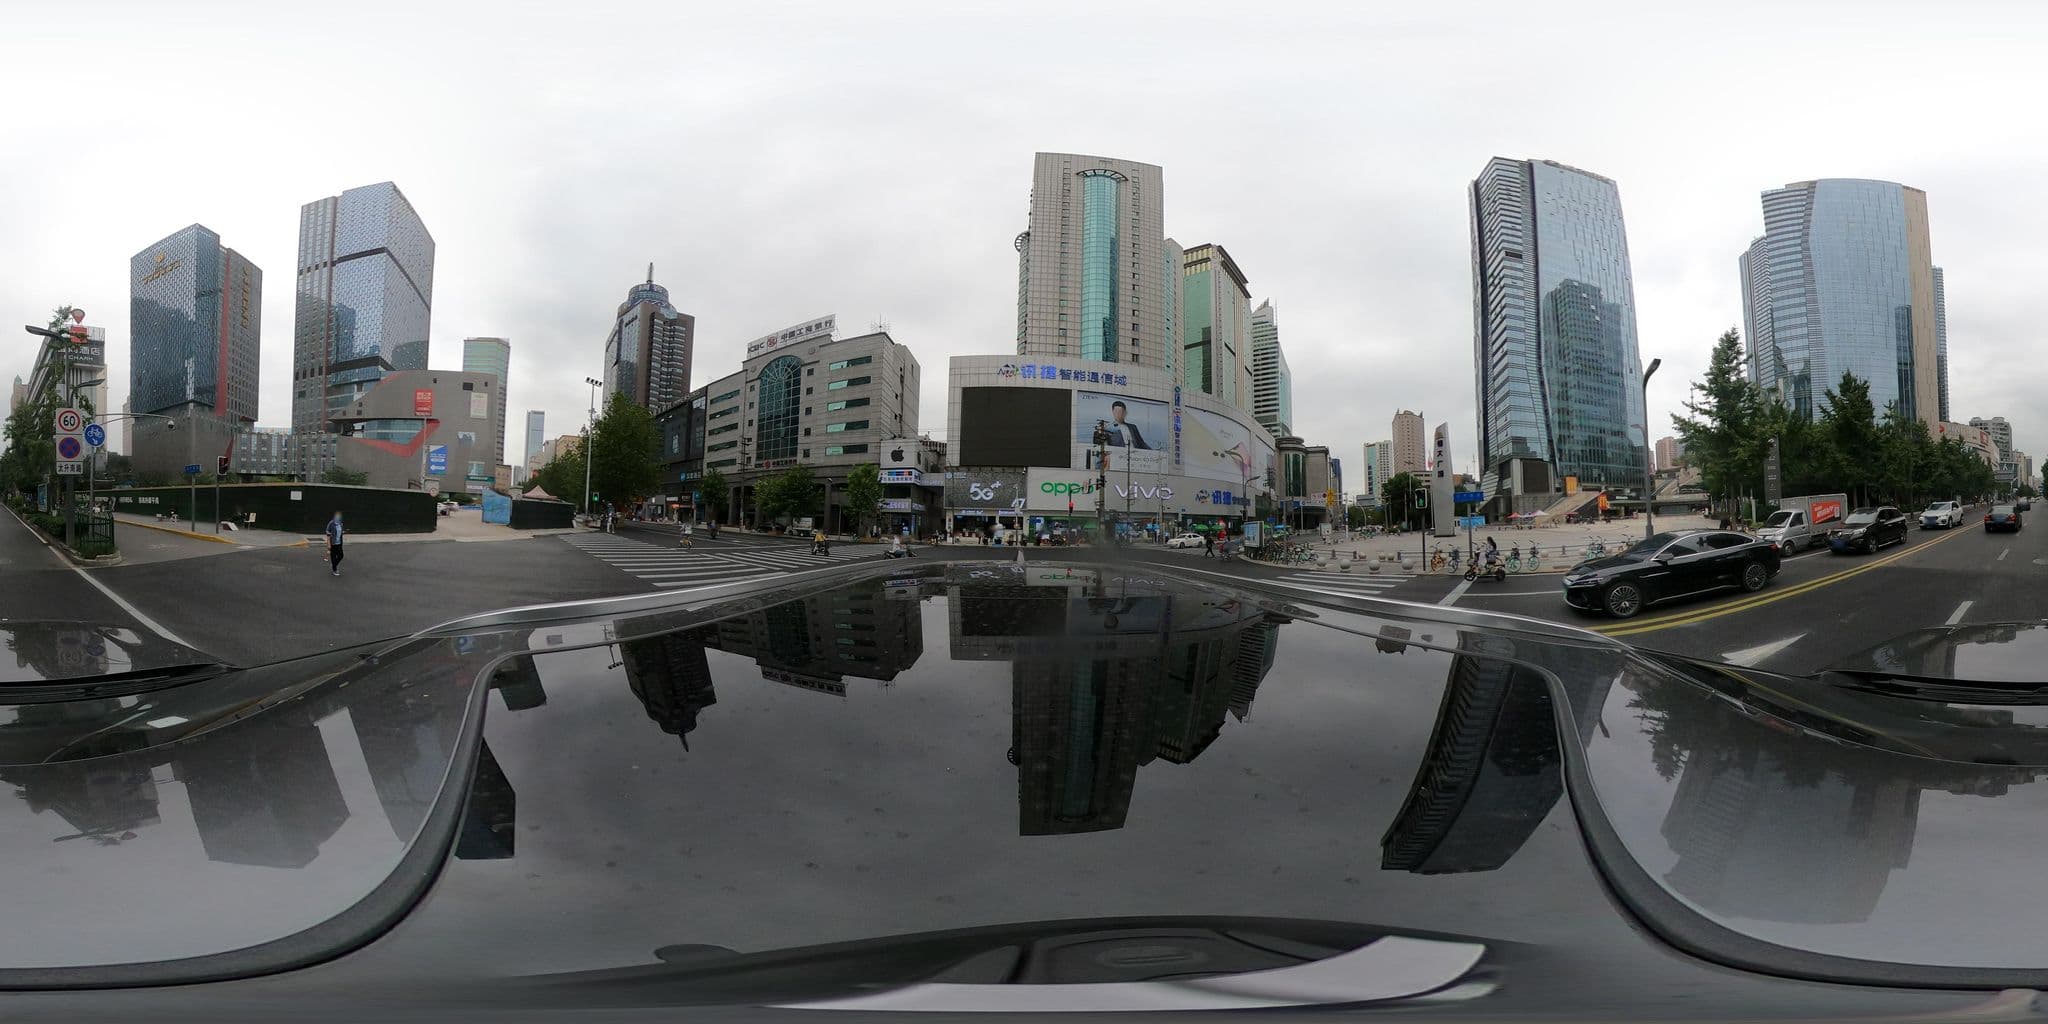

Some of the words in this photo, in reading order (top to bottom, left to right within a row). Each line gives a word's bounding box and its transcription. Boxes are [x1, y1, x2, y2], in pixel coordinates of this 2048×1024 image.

[780, 319, 833, 341] 中国工商银行
[63, 415, 76, 427] 60
[1114, 481, 1175, 500] vivo
